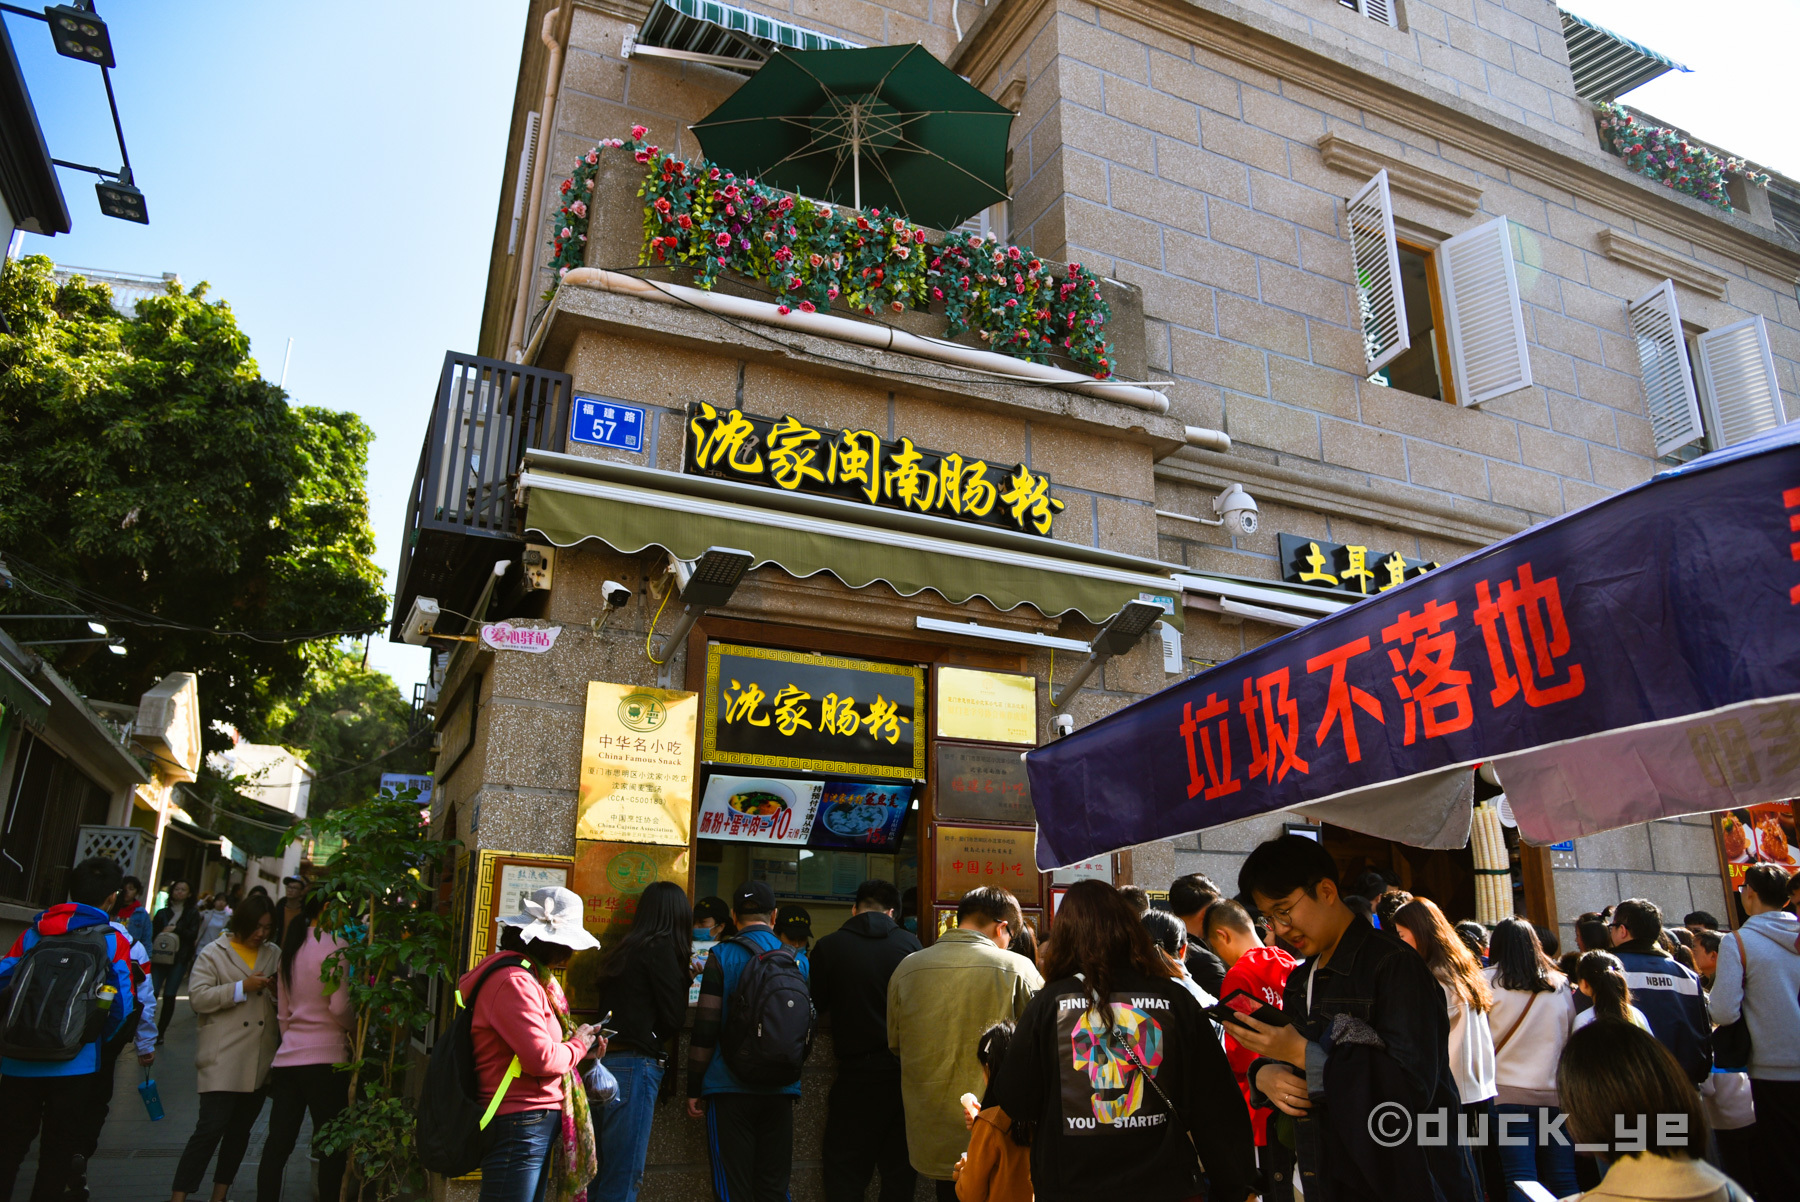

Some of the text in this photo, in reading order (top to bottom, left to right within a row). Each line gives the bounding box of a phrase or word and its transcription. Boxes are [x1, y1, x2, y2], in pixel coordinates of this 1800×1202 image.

[583, 403, 635, 423] 福建路
[592, 419, 617, 441] 57
[691, 401, 1065, 535] 沈家闽南肠粉
[1299, 542, 1441, 595] 土耳其
[491, 627, 550, 646] 爱心驿站
[1179, 561, 1586, 801] 垃圾不落地
[723, 678, 910, 745] 沈家肠粉
[599, 734, 682, 756] 中华名小吃
[598, 751, 682, 766] China Famous Snack
[588, 767, 688, 783] 厦门市思明区小沈家小吃店
[952, 777, 1026, 796] 福建名小吃
[799, 785, 822, 840] 持预付卡请从边门
[952, 860, 1024, 876] 中国名小吃
[588, 896, 637, 913] 中华名
[586, 915, 611, 924] China
[1645, 976, 1673, 987] NBHD
[1059, 998, 1170, 1011] FINI WHAT
[1067, 1117, 1096, 1129] YOU
